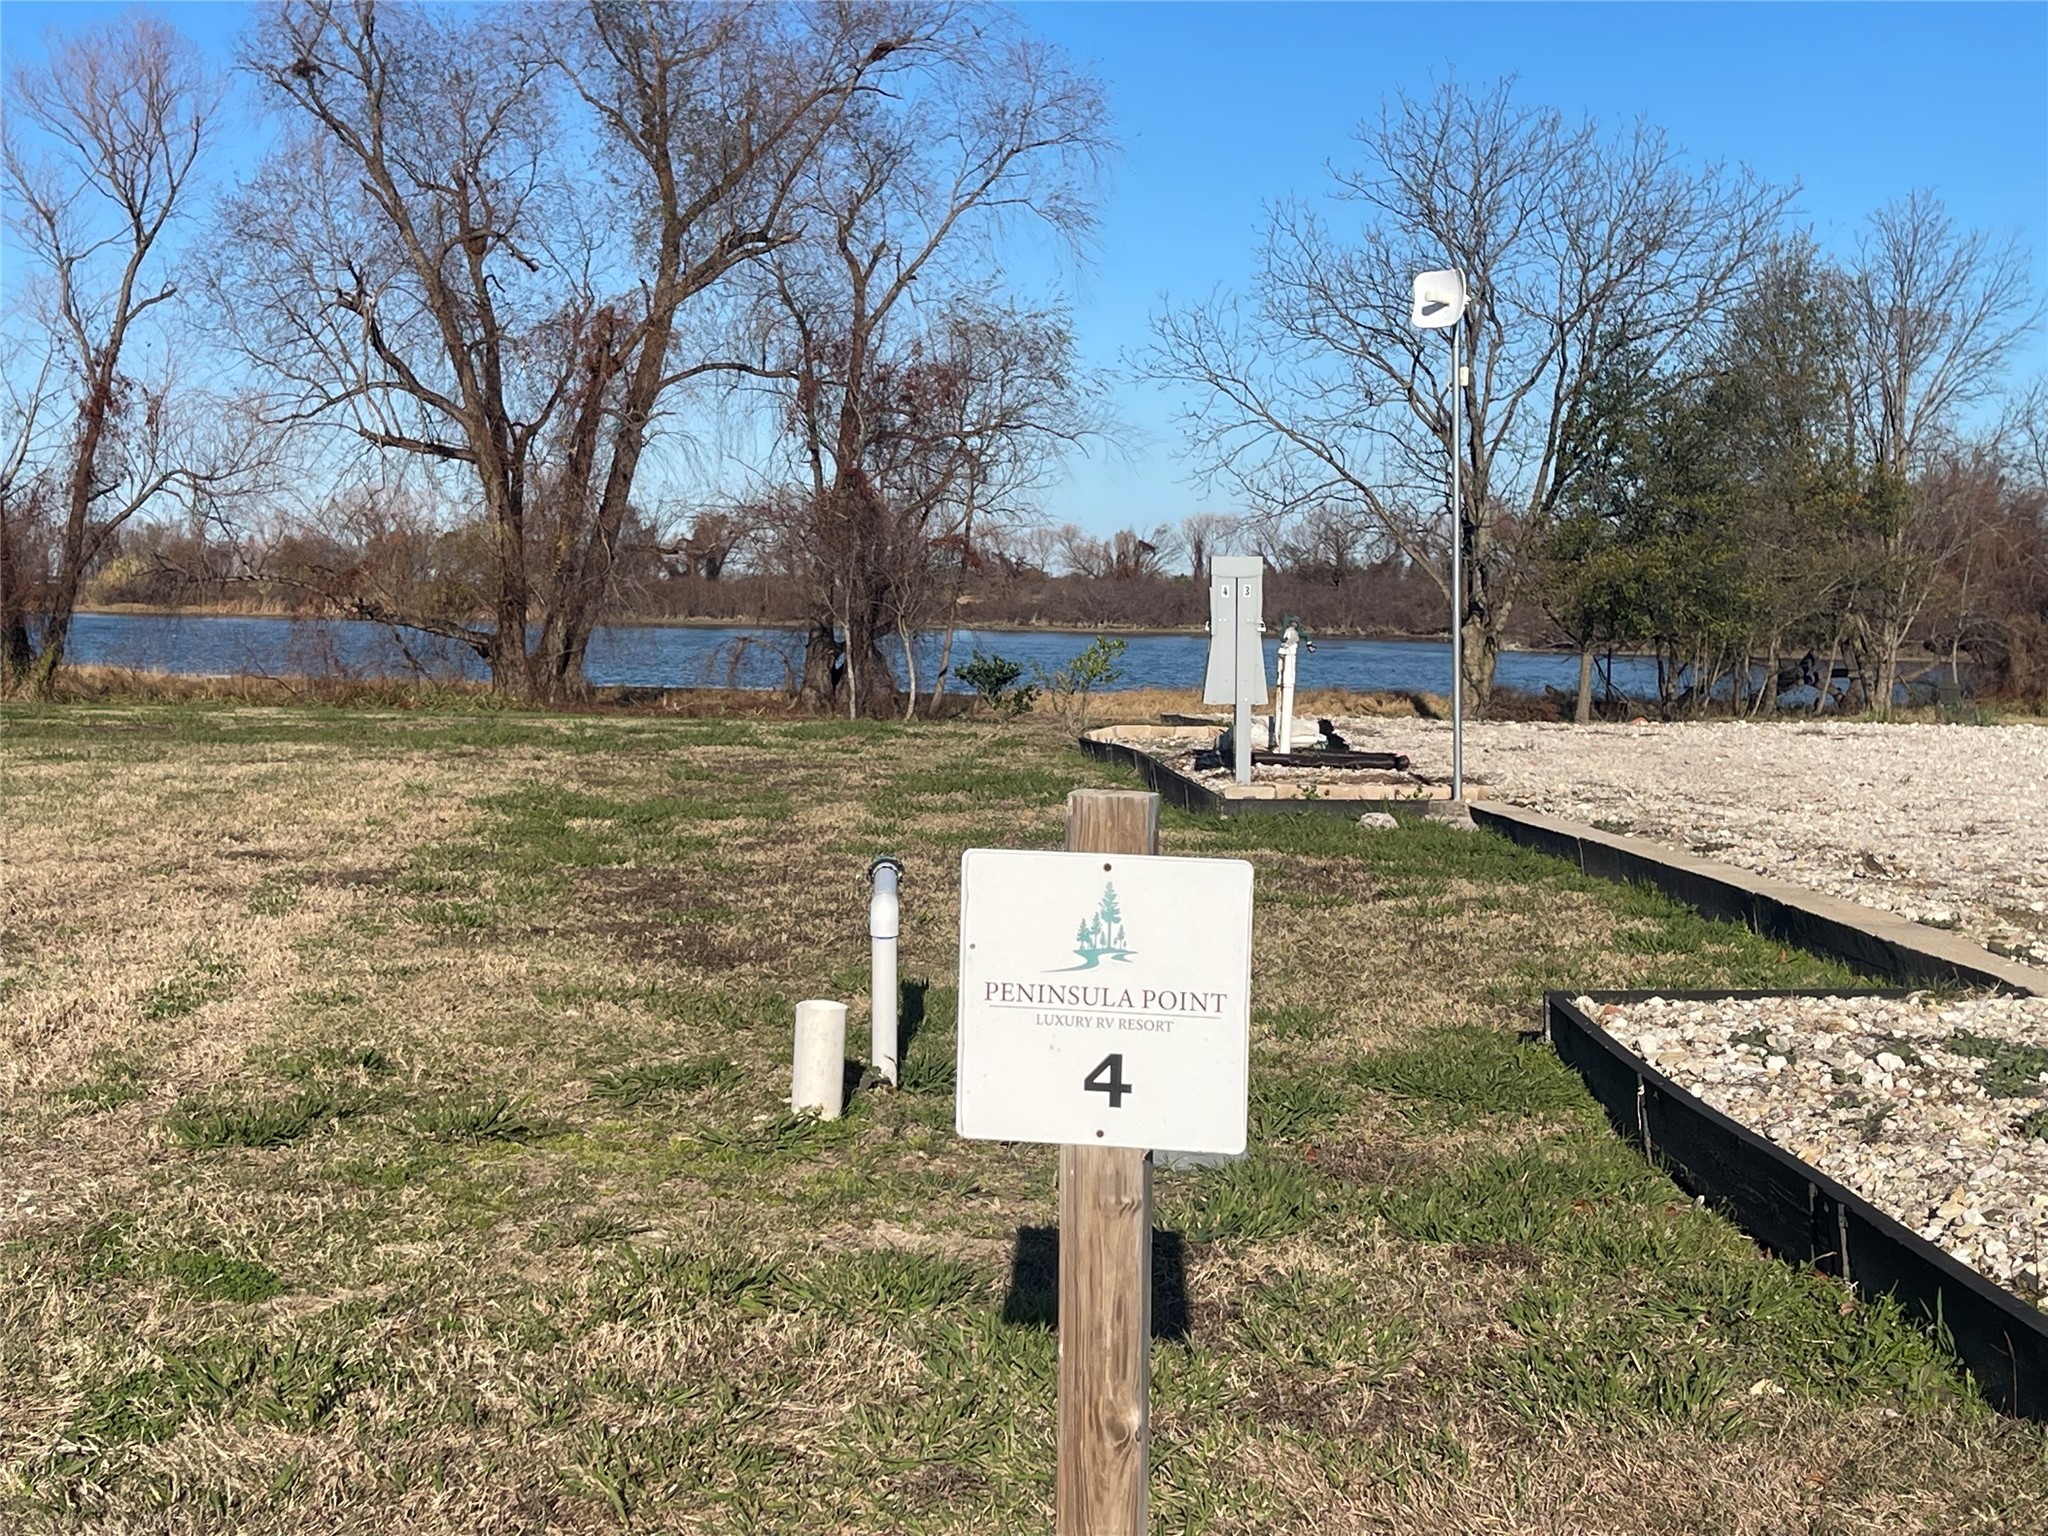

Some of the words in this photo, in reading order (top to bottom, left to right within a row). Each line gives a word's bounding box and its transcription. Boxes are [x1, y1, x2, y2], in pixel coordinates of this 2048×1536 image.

[984, 981, 1134, 1008] PENINSULA
[1142, 989, 1228, 1013] POINT
[1036, 1013, 1093, 1029] LUXURY
[1096, 1017, 1115, 1030] RV
[1118, 1018, 1175, 1033] RESORT
[1083, 1053, 1132, 1108] 4
